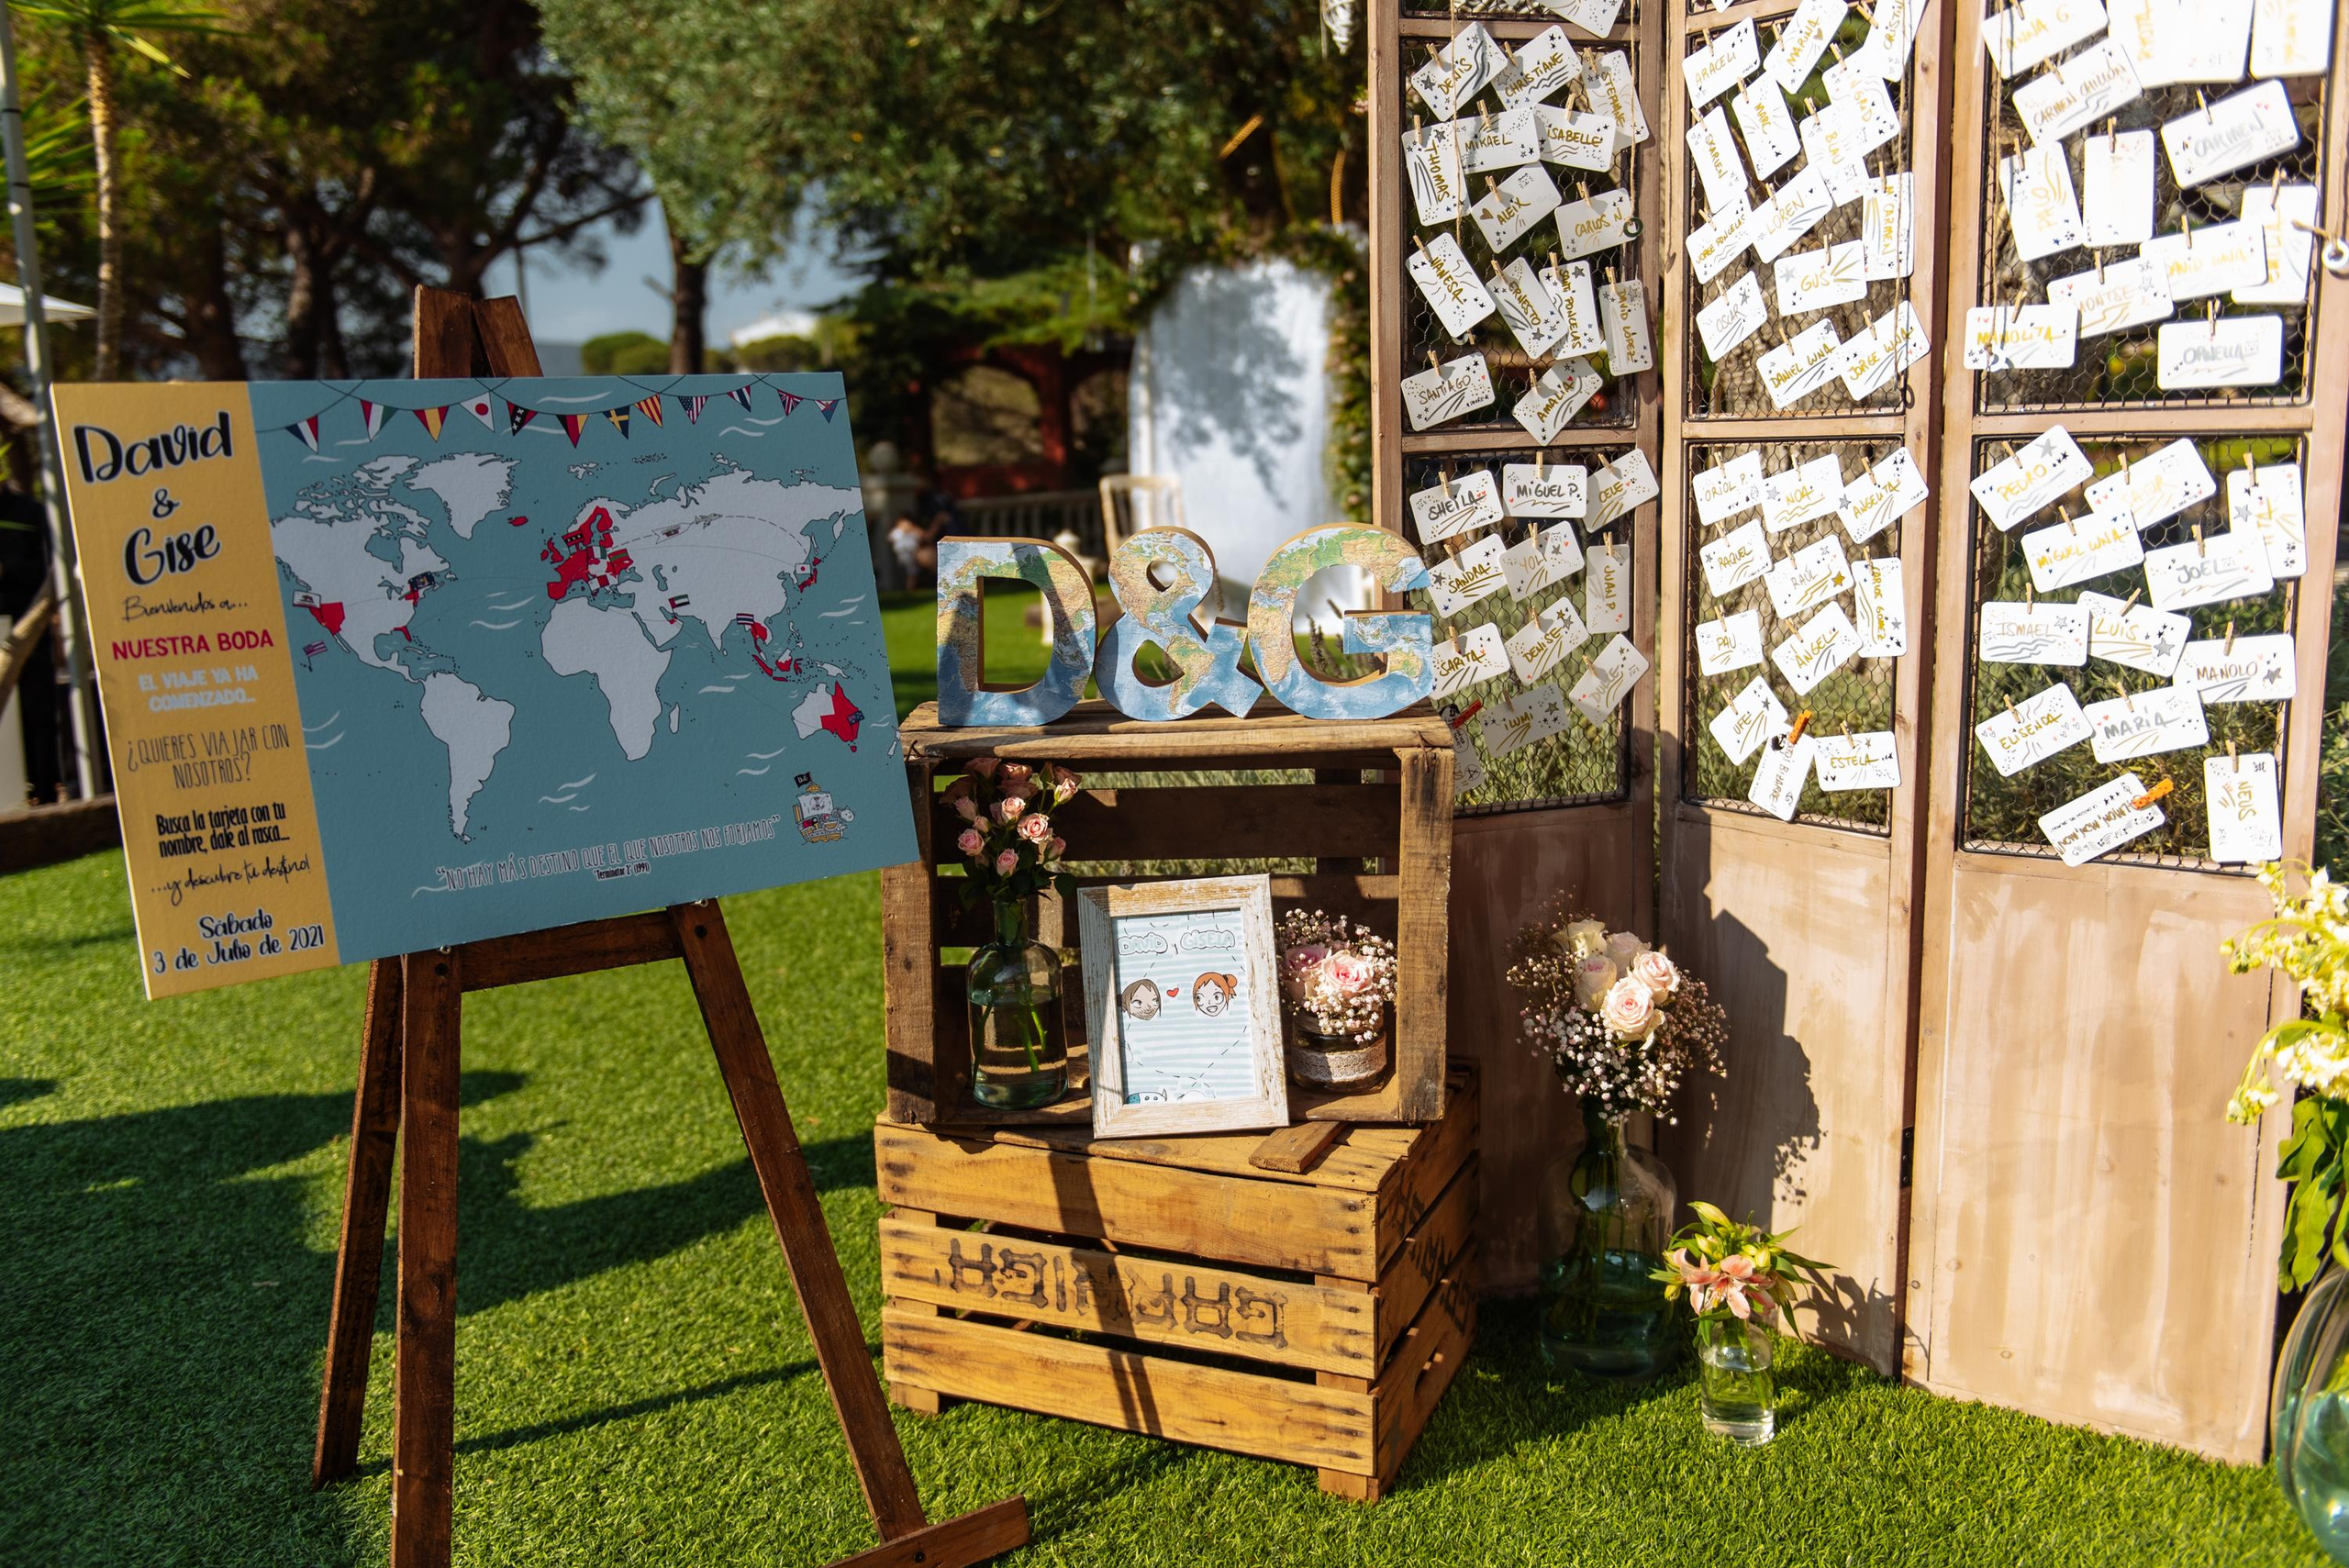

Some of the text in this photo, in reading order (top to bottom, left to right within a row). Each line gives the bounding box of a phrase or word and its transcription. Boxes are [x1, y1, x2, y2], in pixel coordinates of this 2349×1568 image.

[1786, 17, 1820, 67] MARINA
[2006, 17, 2049, 51] ANNA
[1438, 58, 1473, 95] DENIS
[1504, 52, 1563, 97] CHRISTIANE
[1695, 52, 1736, 84] ARACELI
[1600, 71, 1626, 128] STEPHANE
[2033, 92, 2077, 126] CARMEN
[1754, 103, 1771, 135] MARC
[2194, 109, 2265, 158] CARMEN
[1465, 134, 1513, 151] MIKAEL
[1547, 128, 1603, 148] ISABELLE
[1825, 131, 1843, 164] BLAU
[1424, 140, 1450, 202] THOMAS
[1497, 197, 1531, 226] ALEIX
[1574, 213, 1611, 238] CARLOS
[1766, 191, 1805, 234] LOREN
[1696, 214, 1745, 264] JORGE PONCELAS
[1882, 204, 1897, 255] CARMEN
[1430, 256, 1466, 306] VANESA
[1800, 272, 1830, 292] GUS
[1508, 281, 1542, 327] ERNESTO
[1559, 268, 1582, 350] SANTI PONCELAS
[1716, 304, 1745, 332] OSCAR
[1617, 288, 1637, 361] DAVID LÓPEZ
[1977, 326, 2065, 345] MANOLITA
[1770, 343, 1836, 388] DANIEL LUNA
[1849, 327, 1914, 381] JORGE LUNA
[1419, 374, 1472, 406] SANTIAGO
[1537, 380, 1575, 423] AMALIA
[73, 411, 232, 483] David
[1598, 481, 1623, 504] CELE
[1704, 482, 1736, 501] ORIOL
[1786, 486, 1814, 505] NOA
[1997, 463, 2047, 502] PEDRO
[152, 489, 179, 517] &
[125, 525, 220, 584] Gise
[2088, 527, 2132, 553] LUNA
[1520, 550, 1547, 574] YOLI
[1717, 546, 1753, 570] RAQUEL
[2176, 560, 2240, 584] JOEL
[1448, 562, 1491, 594] SANDRA
[1603, 565, 1617, 599] JUAN
[122, 592, 215, 622] Bienvenidos
[112, 629, 274, 661] NUESTRA BODA
[1522, 627, 1562, 663] DENISE
[1716, 634, 1736, 651] PAU
[1997, 622, 2064, 638] ISMAEL
[2095, 617, 2141, 640] LUIS
[1439, 649, 1485, 677] SARITA
[1790, 630, 1839, 669] ÁNGEL
[139, 664, 258, 692] EL VIAJE YA HA
[1589, 665, 1620, 703] DULCE
[2197, 661, 2258, 683] MANOLO
[128, 724, 290, 772] ¿QUIERES VIAJAR CON
[1831, 754, 1878, 768] ESTELA
[173, 751, 250, 789] NOSOTROS?
[2238, 781, 2257, 822] NEUS
[155, 802, 286, 836] Busca la tarjeta con tu
[159, 835, 207, 858] nombre,
[211, 829, 234, 851] dale
[238, 827, 250, 847] al
[466, 862, 494, 887] HAY
[497, 852, 527, 883] MÁS
[529, 849, 579, 878] DESTINO
[581, 845, 605, 869] QUE
[607, 842, 621, 864] EL
[623, 838, 646, 862] QUE
[648, 830, 699, 858] NOSOTROS
[700, 826, 722, 849] NOS
[184, 863, 242, 890] descubre
[243, 859, 259, 884] tu
[262, 853, 310, 884] destino!
[199, 907, 273, 940] Sábado
[153, 925, 324, 973] 3 de Julio de 2021
